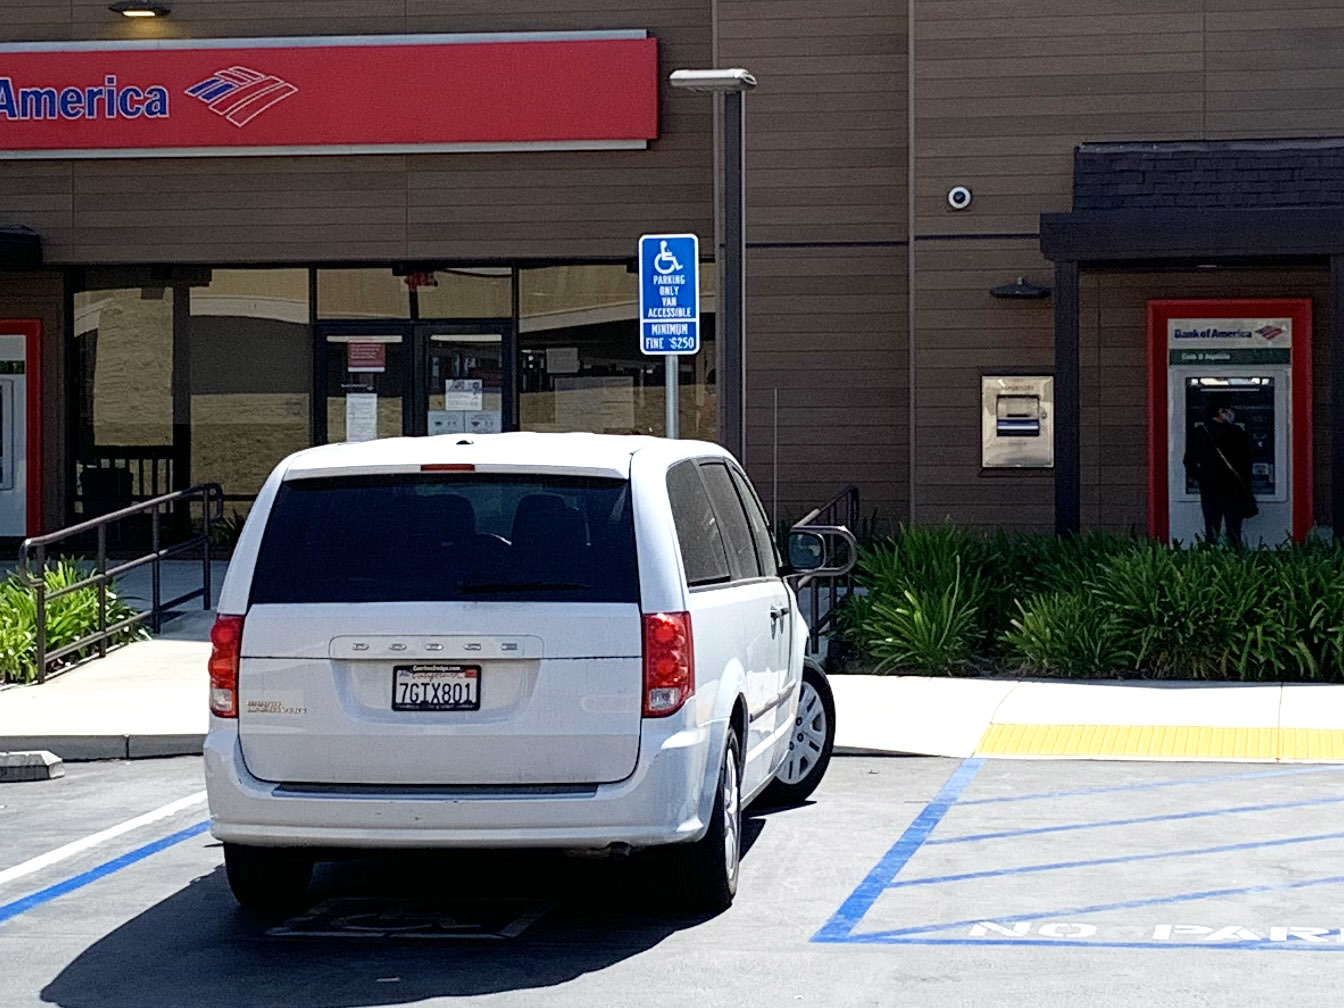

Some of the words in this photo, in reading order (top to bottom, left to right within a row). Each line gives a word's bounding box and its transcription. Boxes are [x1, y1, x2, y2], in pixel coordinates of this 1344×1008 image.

[653, 275, 686, 285] PARKING
[659, 286, 679, 296] ONLY
[662, 297, 677, 307] VAN
[648, 307, 692, 317] ACCESSIBLE
[651, 324, 688, 335] MINIMUM
[1174, 328, 1199, 338] Bank
[1201, 328, 1212, 338] of
[1212, 328, 1252, 338] America
[645, 338, 665, 349] FINE
[669, 336, 695, 349] $250
[967, 921, 1098, 938] NO
